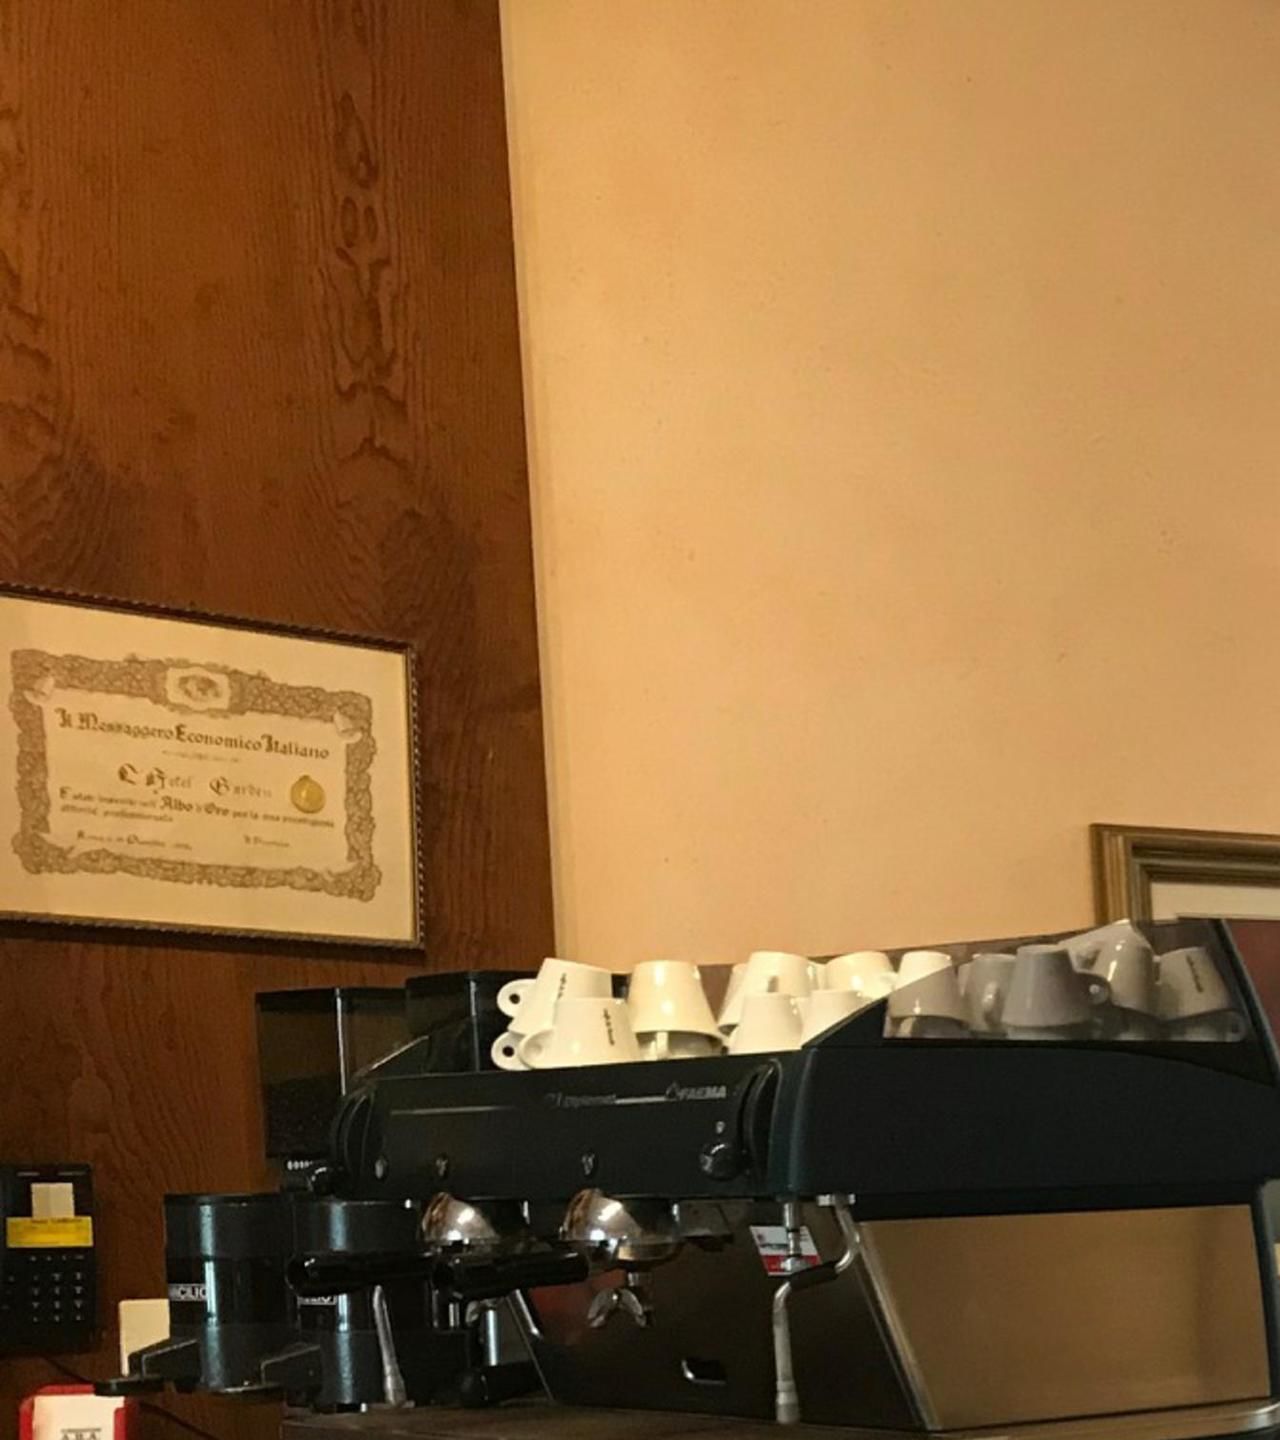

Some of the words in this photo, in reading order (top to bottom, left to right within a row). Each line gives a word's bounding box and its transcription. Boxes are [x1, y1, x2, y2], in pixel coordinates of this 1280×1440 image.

[77, 712, 175, 740] Messaggero
[175, 723, 262, 751] Economico
[261, 734, 329, 760] Italiano
